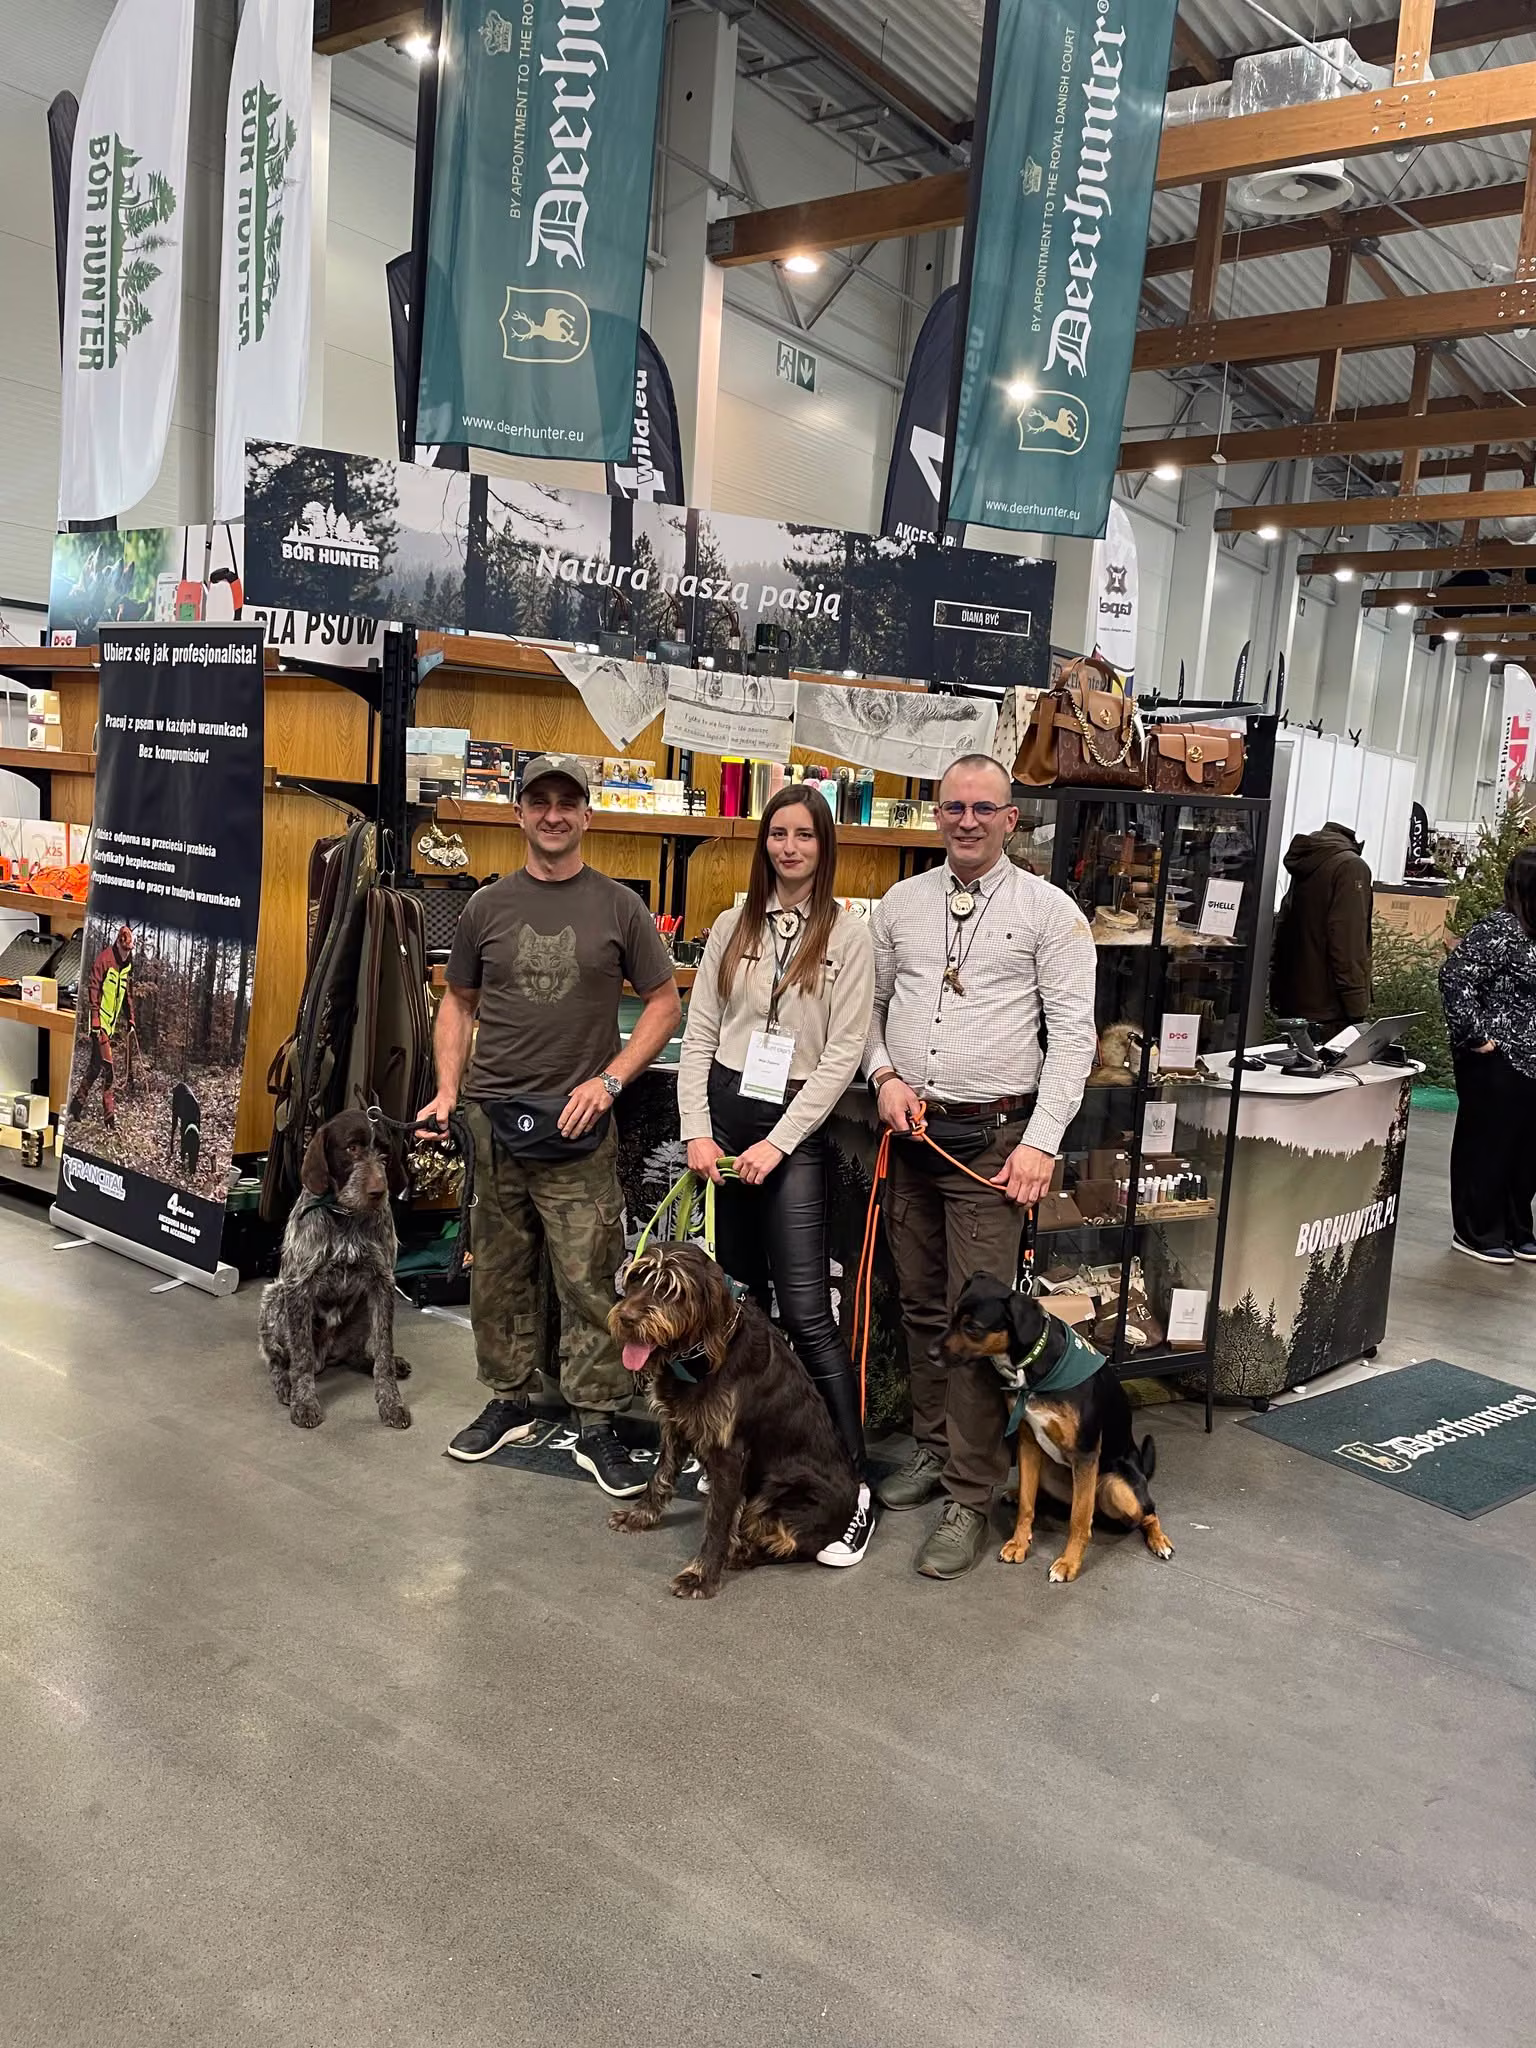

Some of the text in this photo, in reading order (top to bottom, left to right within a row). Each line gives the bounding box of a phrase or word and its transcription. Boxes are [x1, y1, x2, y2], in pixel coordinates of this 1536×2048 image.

[519, 30, 533, 63] THE
[518, 63, 530, 83] TO
[511, 89, 530, 194] APPOINTMENT
[1032, 27, 1076, 332] BY APPOINTMENT TO THE ROYAL DANISH COURT
[510, 203, 521, 219] BY
[78, 134, 112, 371] BÓR HUNTER
[462, 415, 585, 442] www.deerhunter.eu
[985, 500, 1081, 521] www.deerhunter.eu
[282, 542, 379, 570] BÓR HUNTER
[534, 548, 843, 621] Natura naszą pasją
[961, 610, 1000, 626] DIANĄ BYĆ
[103, 642, 257, 667] Ubierz się jak profesjonalista!
[105, 713, 249, 739] Pracuj z psem w każdych warunkach
[138, 743, 210, 764] Bez kompromisów!
[113, 831, 141, 846] odporna
[141, 836, 151, 847] na
[151, 837, 183, 853] przecięcia
[183, 840, 187, 853] i
[186, 842, 217, 858] przebicia
[125, 854, 176, 874] bezpieczeństwa
[136, 878, 146, 891] do
[146, 881, 165, 897] pracy
[165, 885, 171, 896] w
[171, 884, 196, 902] trudnych
[195, 890, 242, 909] warunkach
[1213, 901, 1236, 911] HELLE
[1294, 1193, 1397, 1257] BORHUNTER.PL
